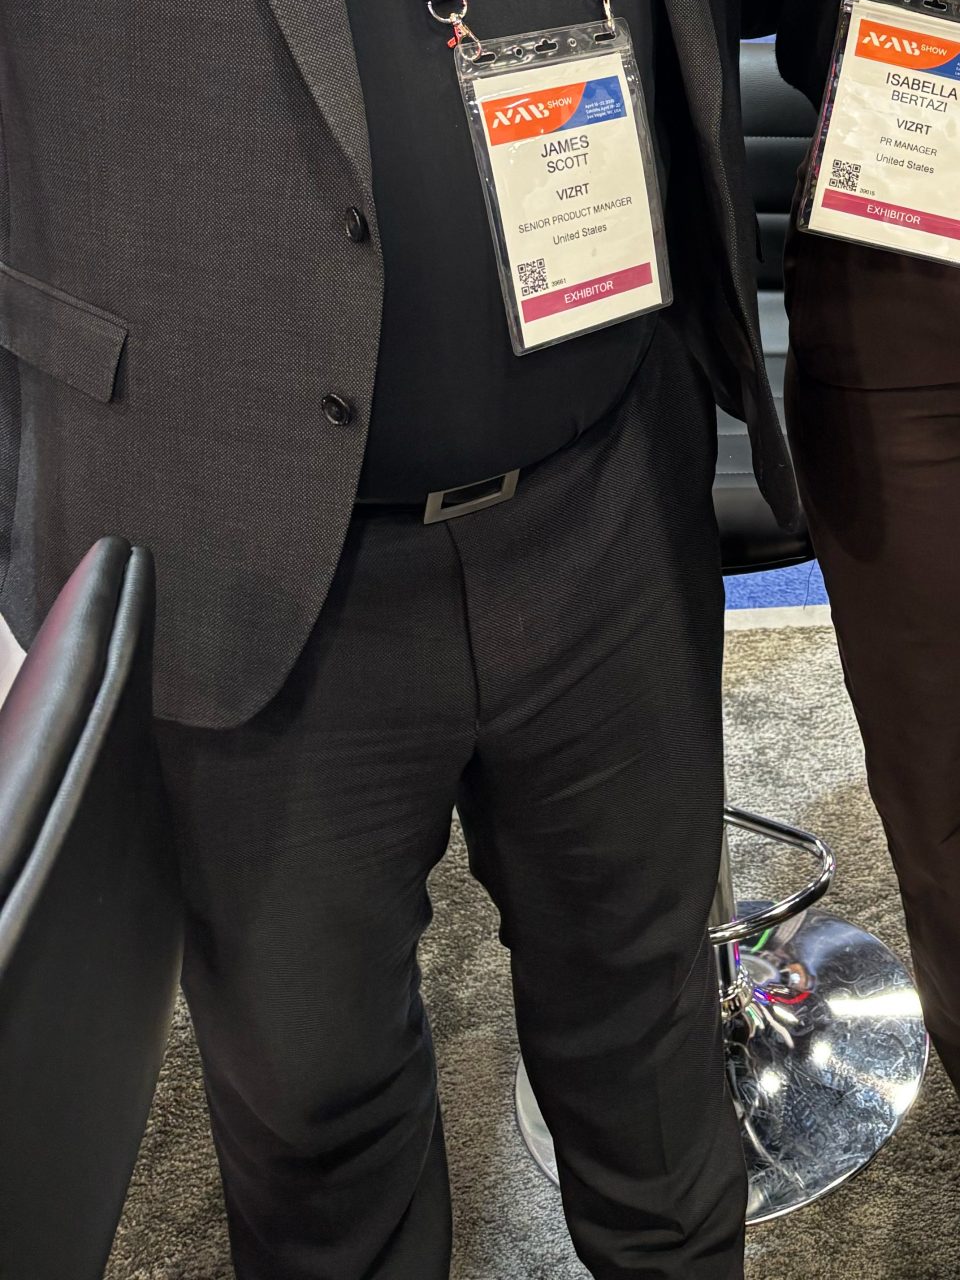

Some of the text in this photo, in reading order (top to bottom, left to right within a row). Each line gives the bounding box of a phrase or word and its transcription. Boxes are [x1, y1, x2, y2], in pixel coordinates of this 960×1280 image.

[862, 31, 947, 56] NAB SHOW
[886, 72, 958, 100] ISABELLA
[891, 90, 948, 113] BERTAZI
[492, 102, 550, 129] NAB
[547, 97, 573, 109] SHOW
[896, 118, 932, 135] VIZRT
[541, 134, 590, 158] JAMES
[880, 136, 938, 156] PR MANAGER
[547, 153, 589, 173] SCOTT
[876, 153, 934, 174] United States
[556, 183, 590, 201] VIZRT
[518, 196, 633, 233] SENIOR PRODUCT MANAGER
[866, 204, 921, 224] EXHIBITOR
[553, 223, 607, 245] United States
[564, 280, 614, 304] EXHIBITOR
